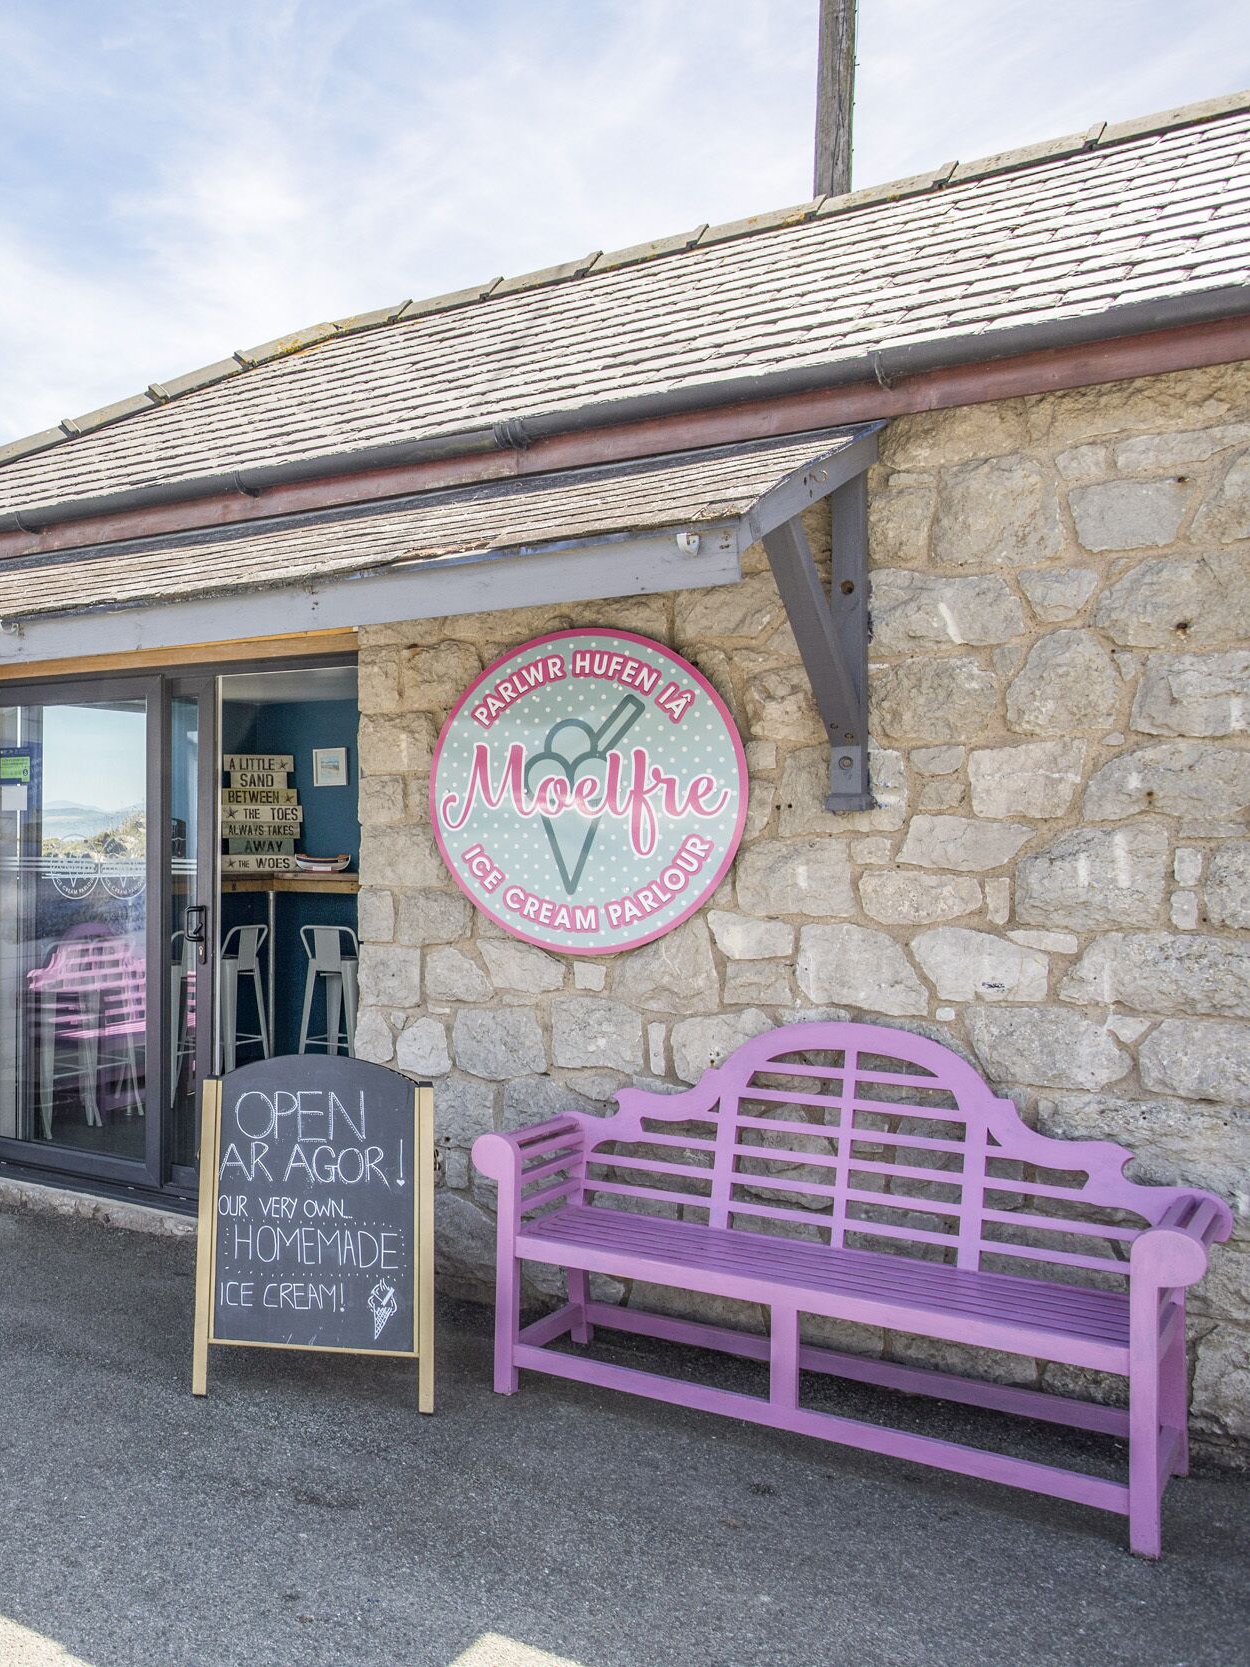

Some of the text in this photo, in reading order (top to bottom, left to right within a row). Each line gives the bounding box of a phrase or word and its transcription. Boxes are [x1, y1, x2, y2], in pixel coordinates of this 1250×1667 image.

[473, 655, 565, 727] PARLWR
[574, 652, 658, 692] HUFEN
[229, 758, 276, 771] A LITTLE
[239, 773, 274, 788] SAND
[228, 790, 280, 804] BETWEEN
[440, 742, 730, 858] Moelfre
[243, 807, 299, 821] THE TOES
[228, 825, 294, 836] ALWAYS TAKES
[244, 840, 284, 853] AWAY
[238, 858, 291, 869] THE WOES
[464, 835, 710, 930] ICE CREAM PARLOUR
[235, 1090, 367, 1142] OPEN
[218, 1142, 274, 1182] AR
[218, 1194, 249, 1216] OUR
[258, 1197, 298, 1219] VERY
[234, 1224, 399, 1270] HOMEMADE
[220, 1281, 346, 1313] ICE CREAM!
